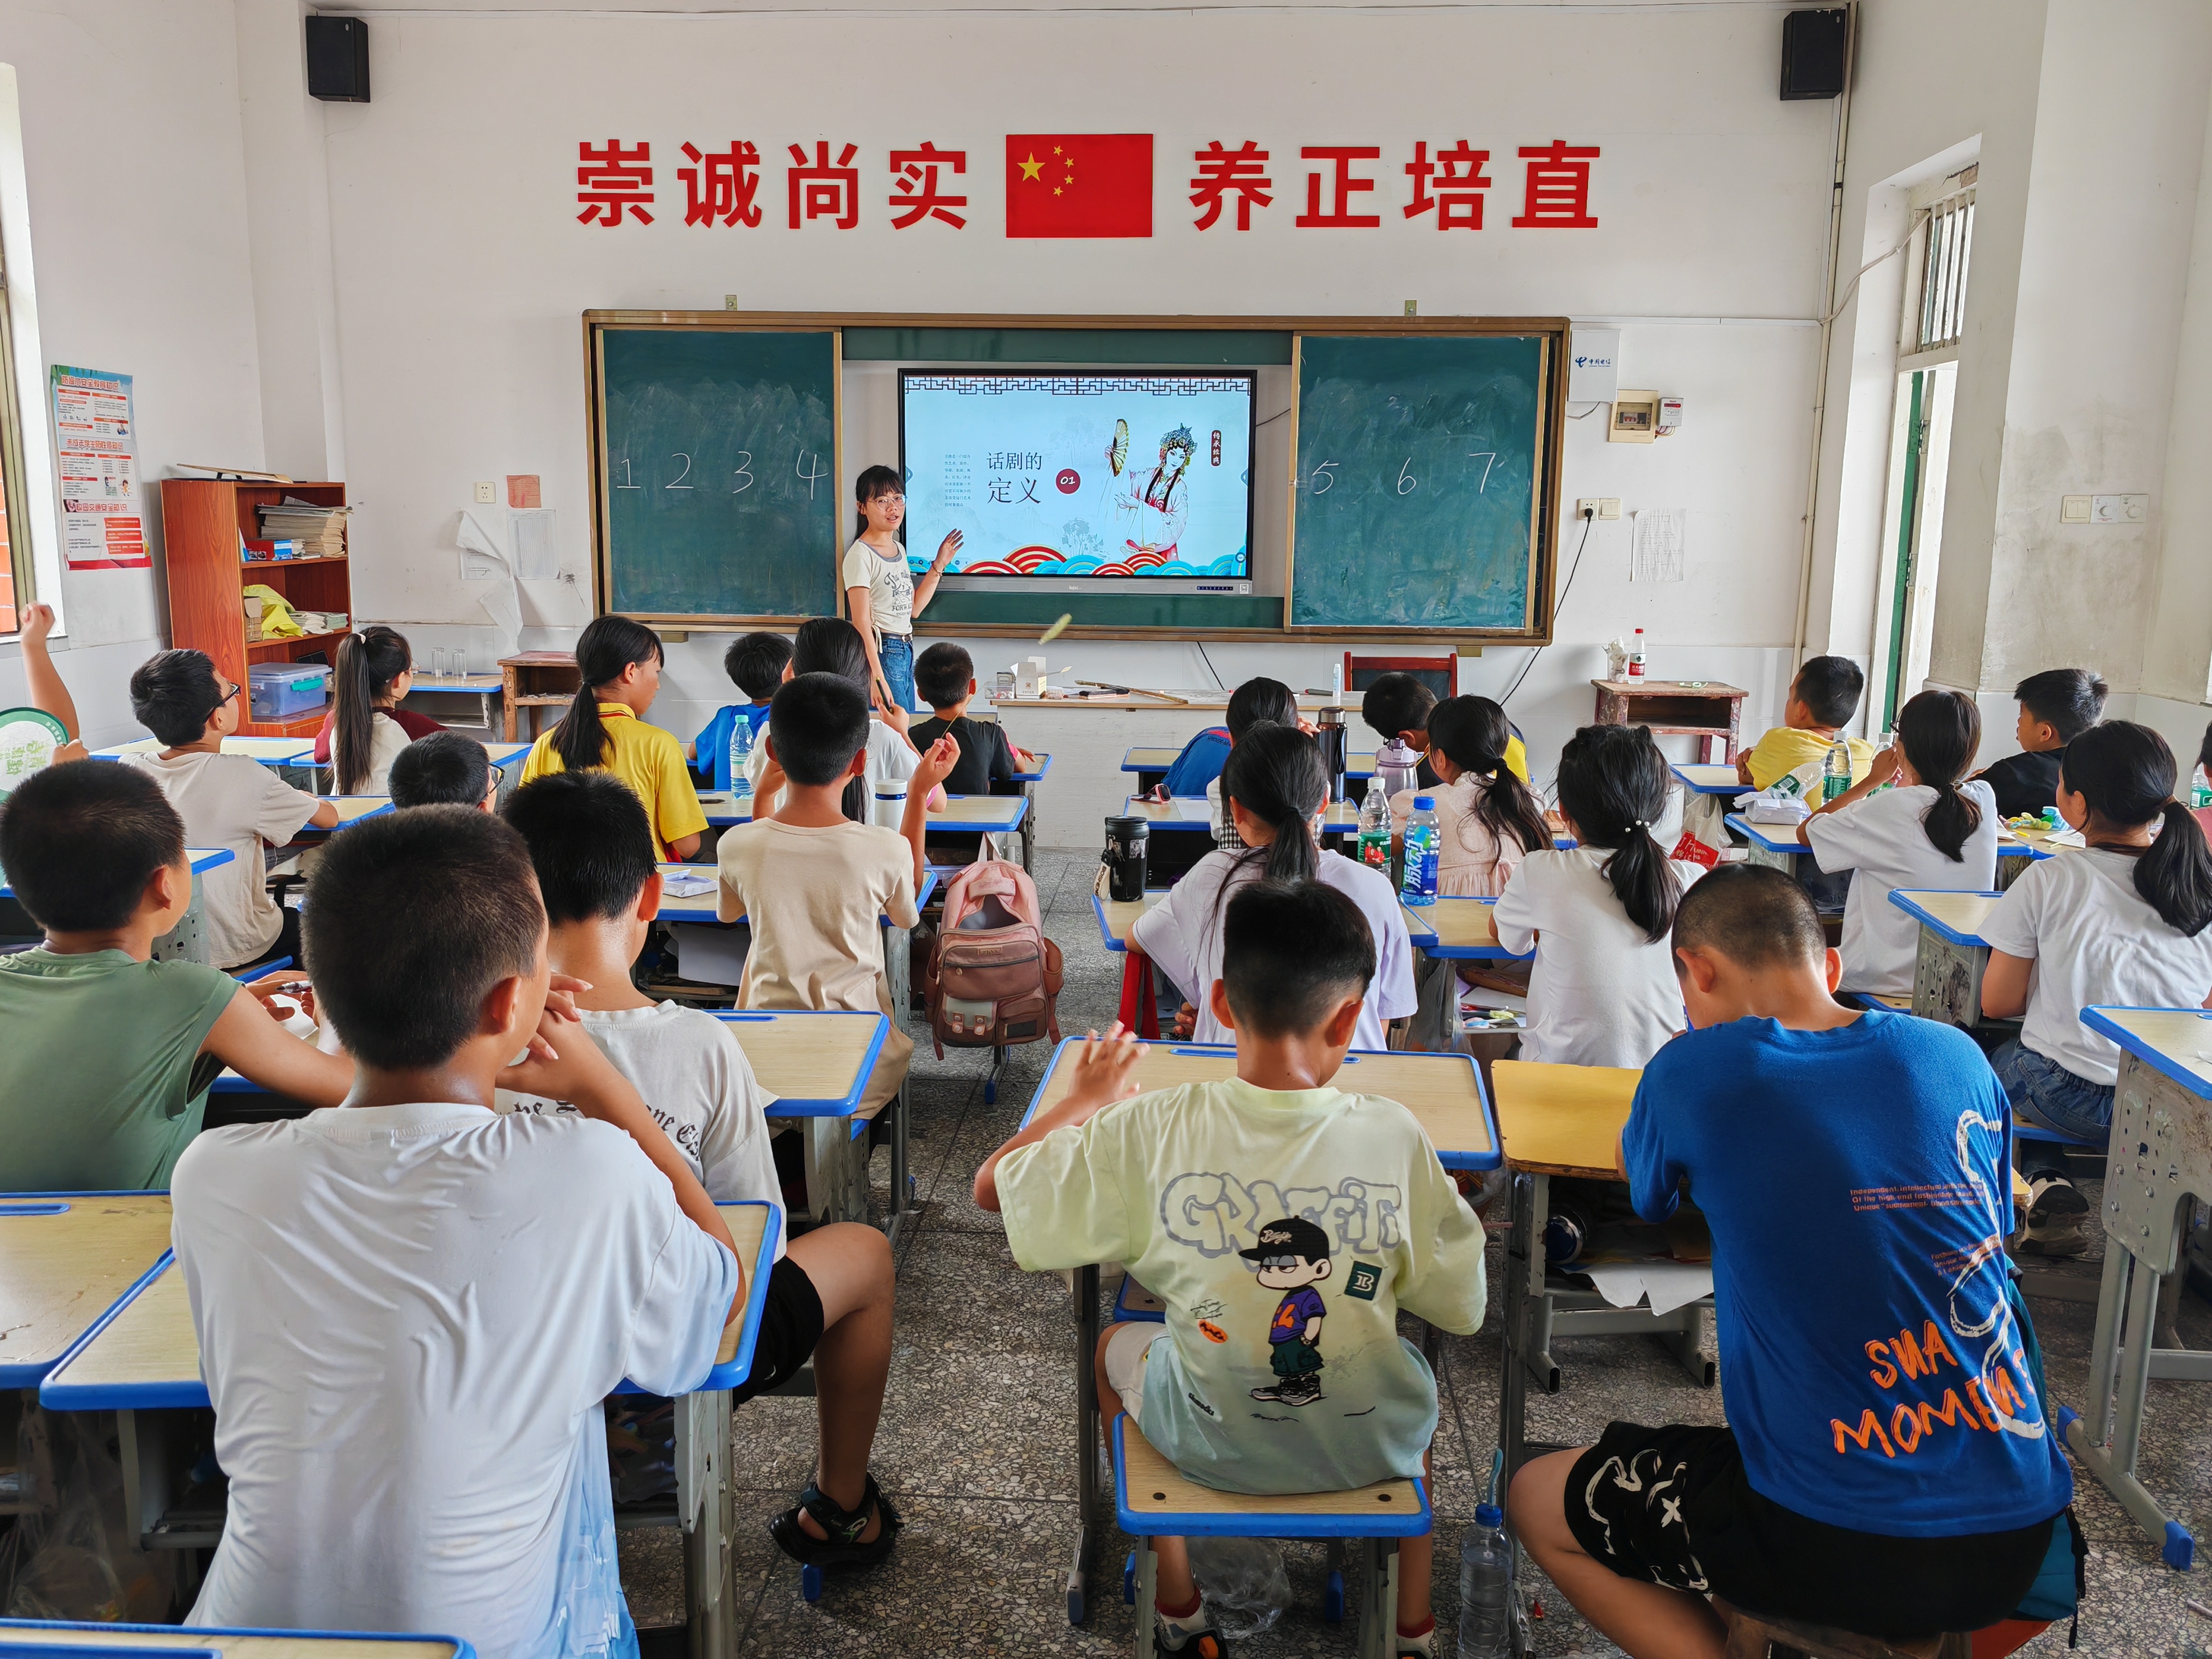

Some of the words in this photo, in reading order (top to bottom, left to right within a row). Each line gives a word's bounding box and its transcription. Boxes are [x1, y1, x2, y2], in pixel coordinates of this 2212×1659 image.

[576, 139, 967, 230] 崇诚尚实
[1188, 139, 1601, 231] 养正培直
[617, 458, 641, 489] 1
[665, 453, 694, 489] 2
[733, 451, 754, 494] 3
[796, 449, 828, 500] 4
[986, 452, 1042, 470] 话剧的
[1060, 476, 1076, 484] 01
[1312, 459, 1339, 494] 5
[1397, 457, 1416, 495] 6
[1469, 452, 1496, 495] 7
[987, 477, 1041, 504] 定义
